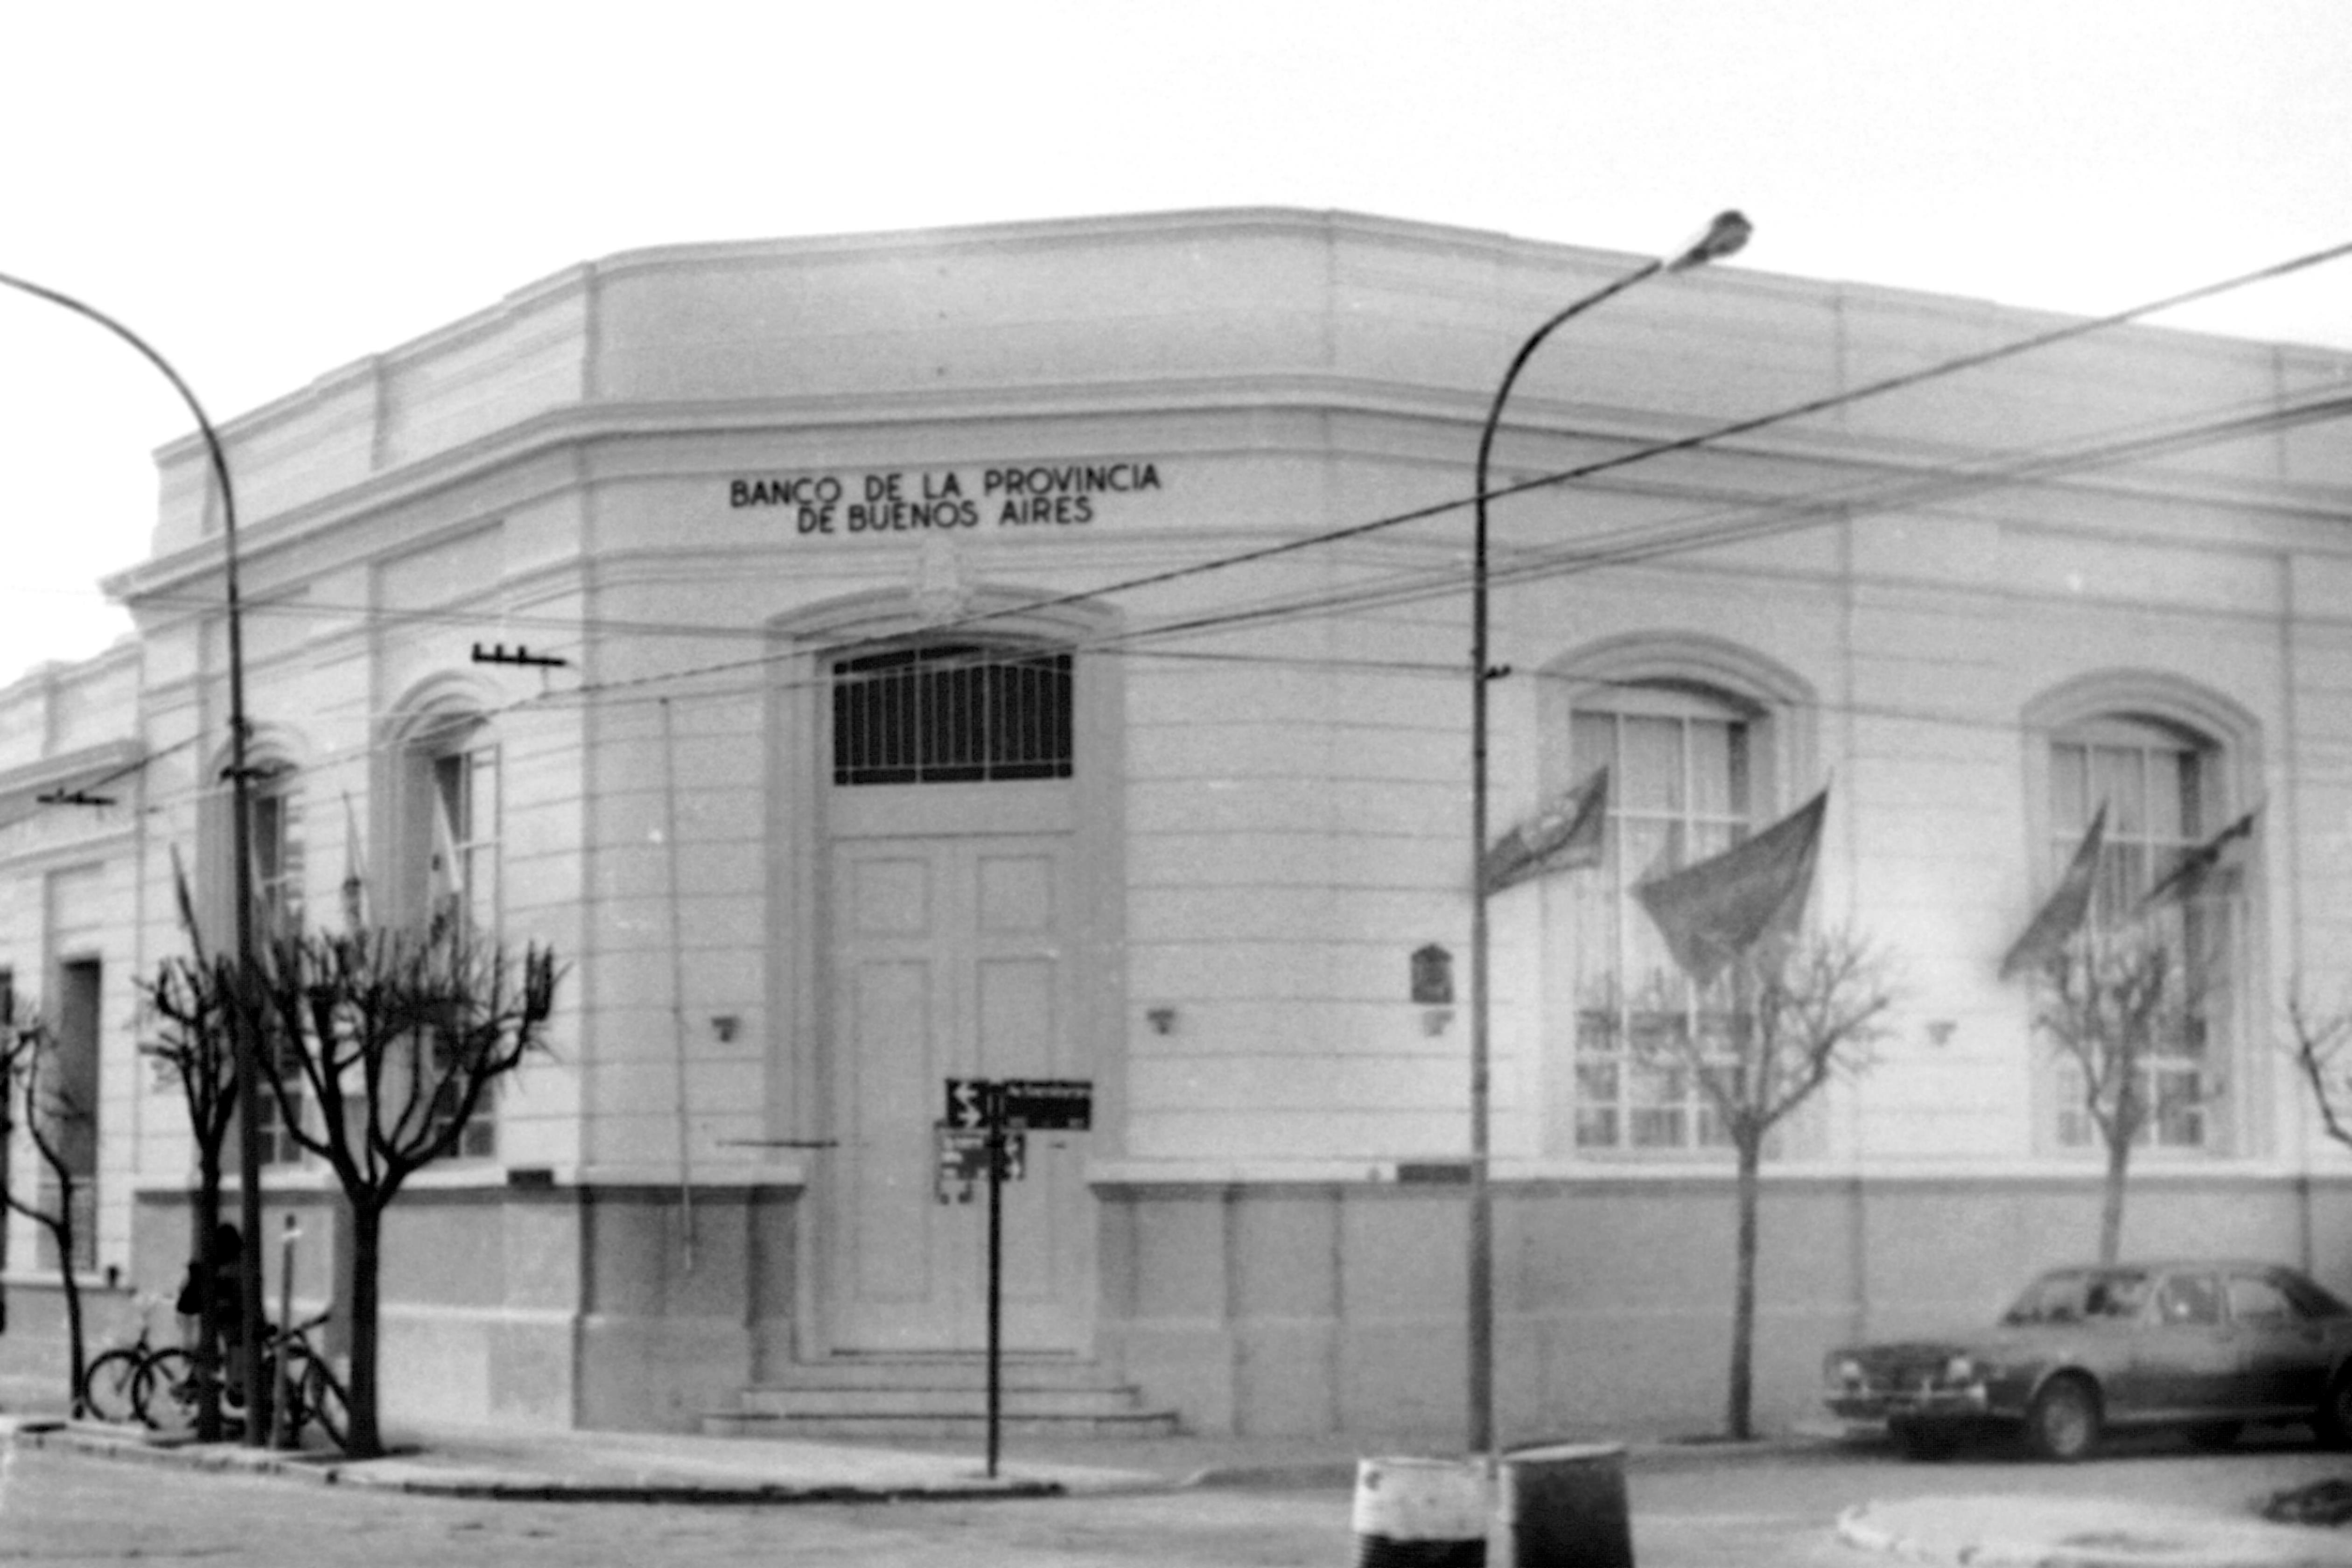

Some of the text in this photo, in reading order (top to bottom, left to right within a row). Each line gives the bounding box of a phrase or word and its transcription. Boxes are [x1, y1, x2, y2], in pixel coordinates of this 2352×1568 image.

[731, 464, 1160, 507] BANCO DE LA PROVINCIA
[798, 497, 1093, 533] DE BUENOS AIRES
